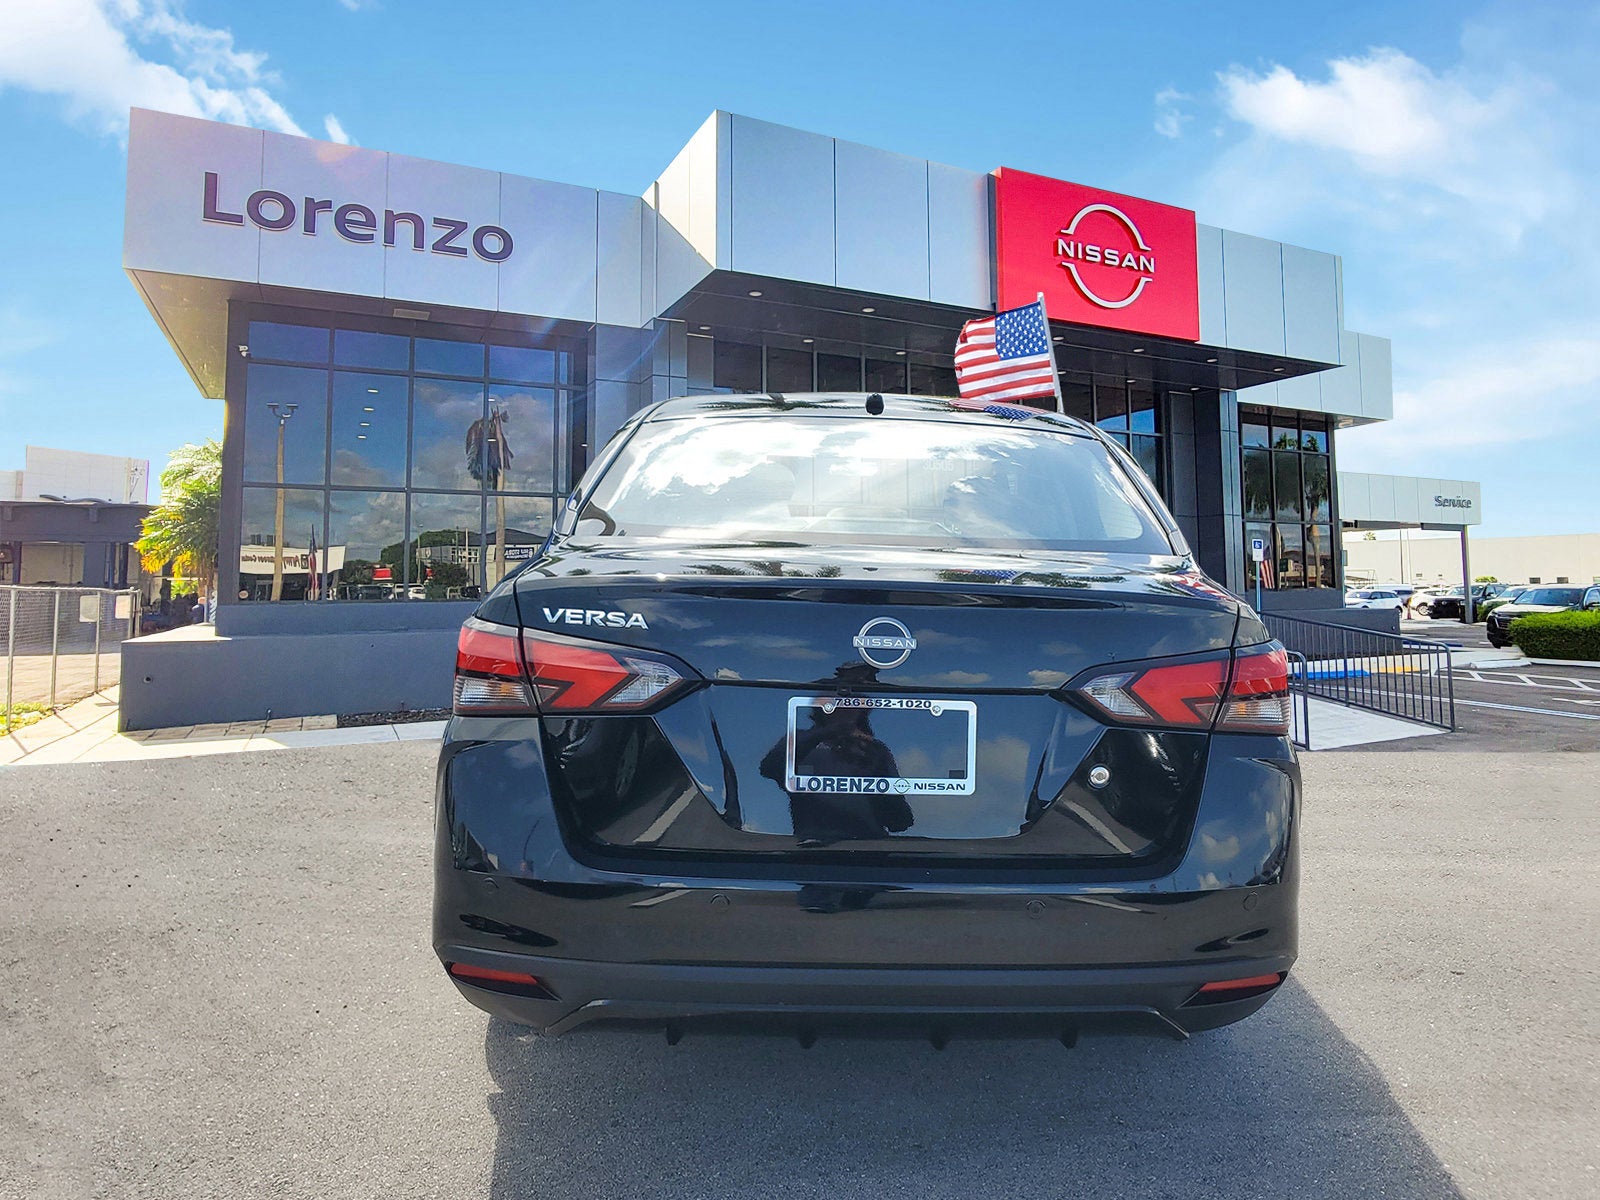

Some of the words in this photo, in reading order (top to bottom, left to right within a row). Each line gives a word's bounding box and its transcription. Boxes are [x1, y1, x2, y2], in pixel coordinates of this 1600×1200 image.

[202, 171, 514, 262] Lorenzo
[1057, 238, 1155, 273] NISSAN
[1434, 495, 1472, 508] Service
[542, 607, 649, 630] VERSA
[855, 638, 915, 649] NISSAN
[834, 698, 932, 709] 786-652-1020
[796, 777, 890, 793] LORENZO
[914, 782, 966, 791] NISSAN
